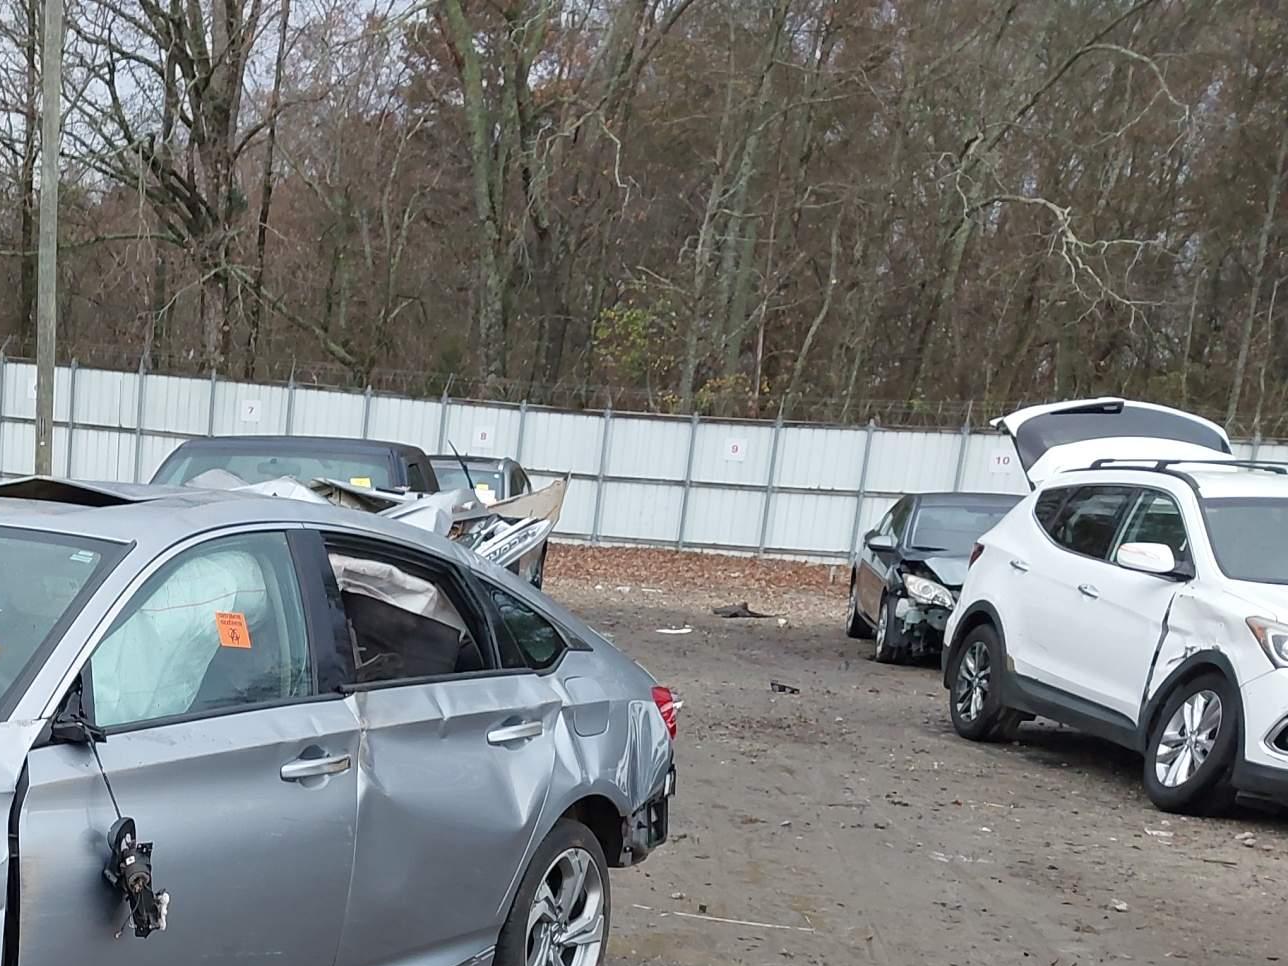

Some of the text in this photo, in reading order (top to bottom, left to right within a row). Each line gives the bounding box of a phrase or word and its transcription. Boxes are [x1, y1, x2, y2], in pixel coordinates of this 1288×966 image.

[247, 406, 255, 415] 7
[731, 444, 739, 454] 9
[995, 455, 1011, 465] 10
[486, 527, 538, 560] ACCOR
